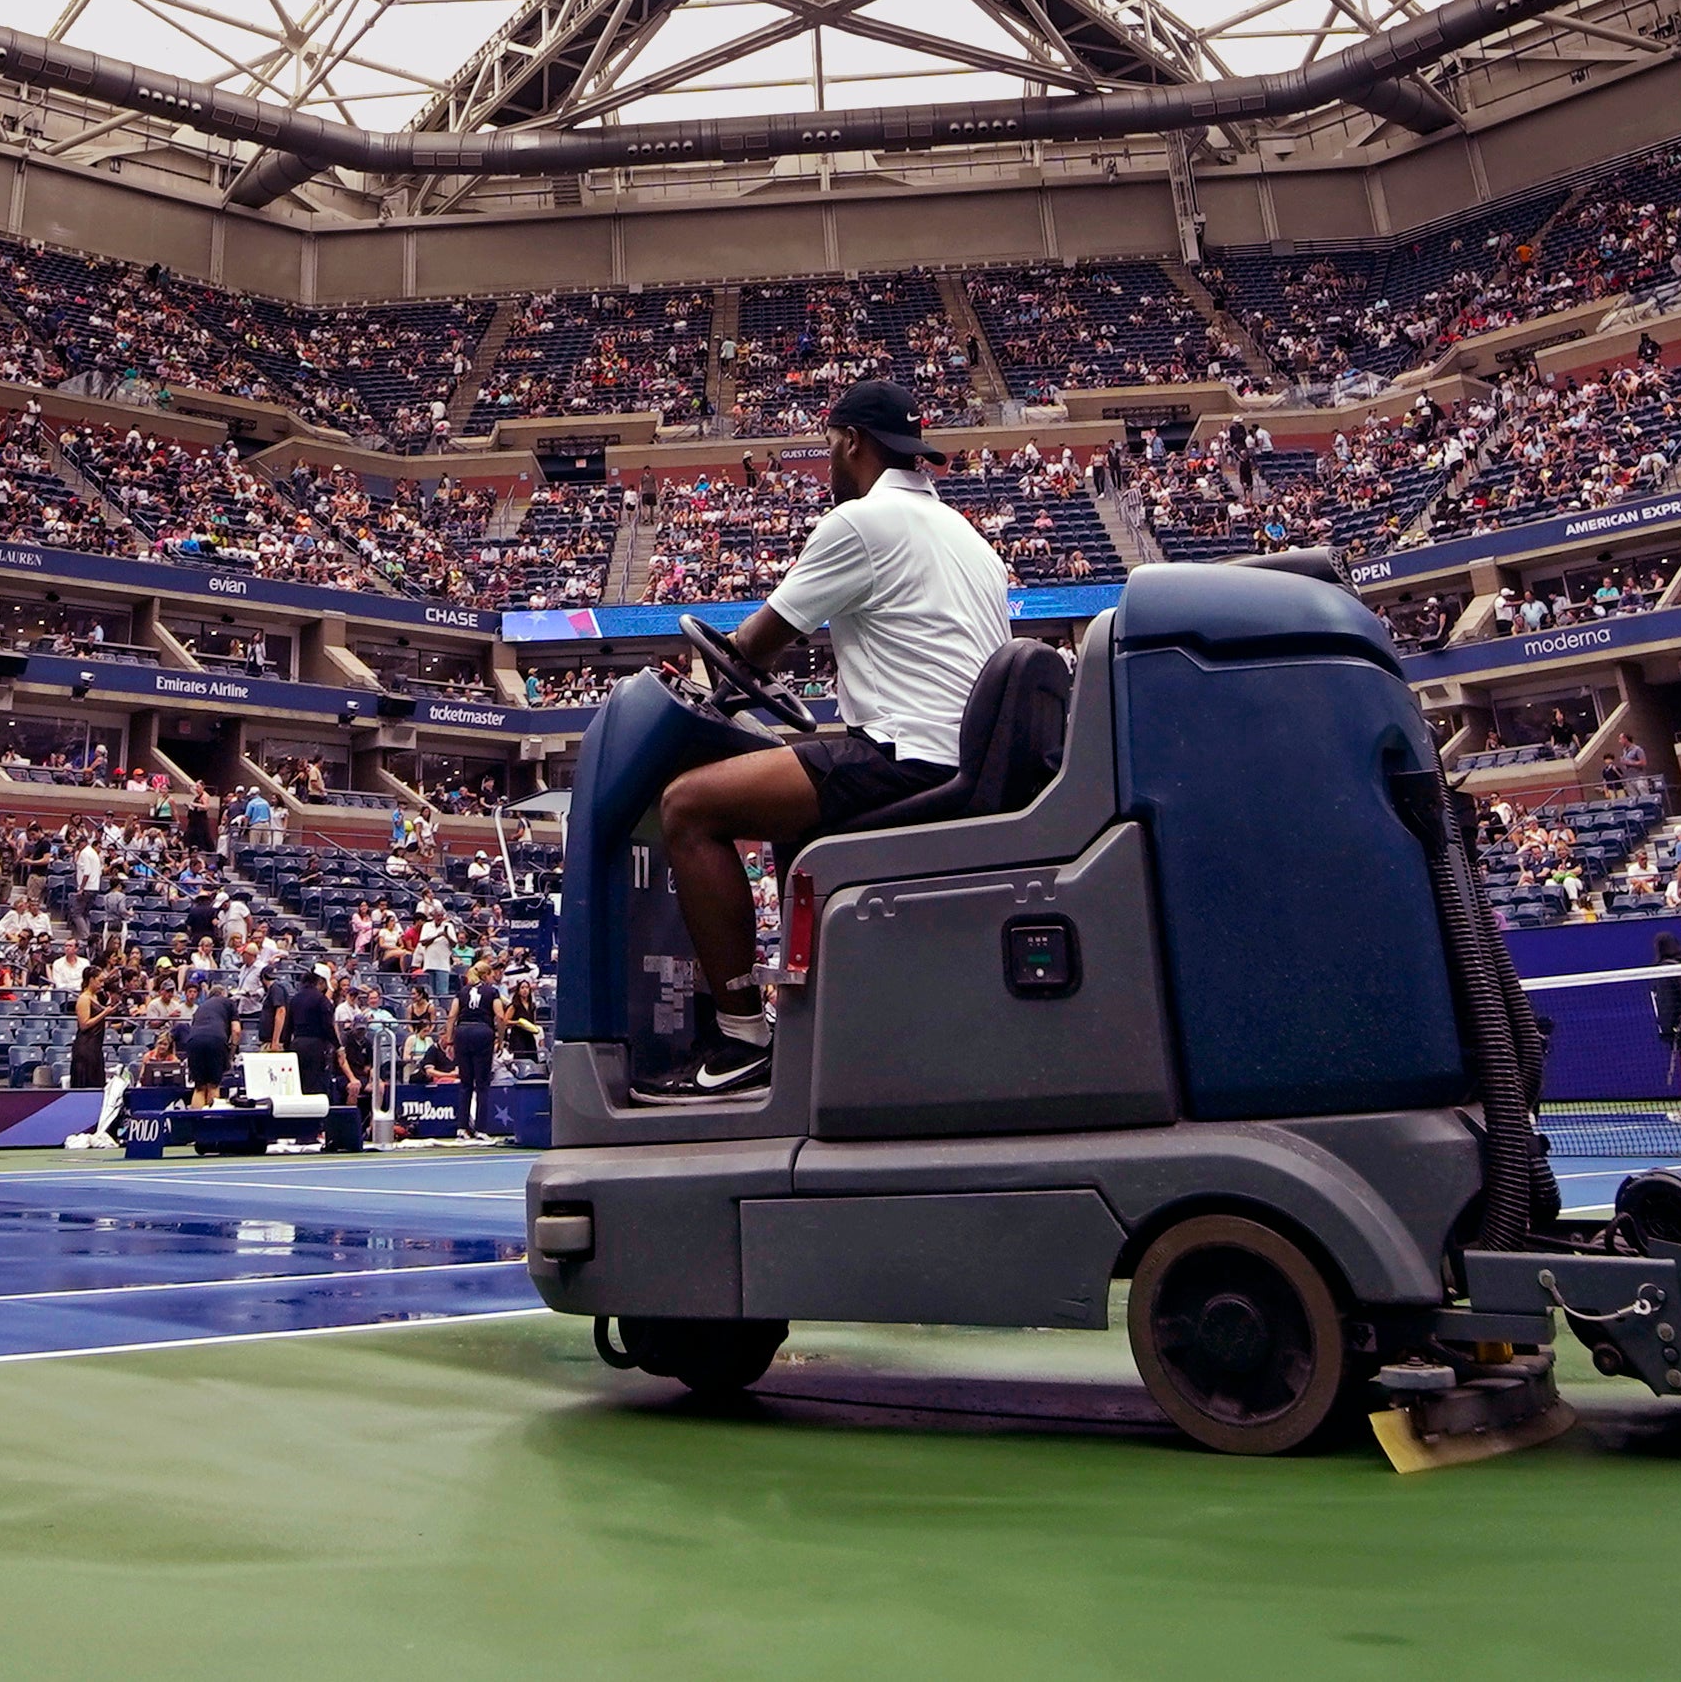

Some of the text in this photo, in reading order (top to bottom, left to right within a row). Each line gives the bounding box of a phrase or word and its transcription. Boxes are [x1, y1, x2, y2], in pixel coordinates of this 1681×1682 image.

[781, 449, 806, 459] GUEST
[1564, 506, 1639, 536] AMERICAN
[1350, 561, 1392, 584] OPEN
[208, 577, 247, 595] evian
[424, 606, 479, 629] CHASE
[1523, 627, 1612, 657] moderna
[155, 674, 250, 700] Emirates Airline
[428, 705, 506, 727] ticketmaster
[401, 1100, 456, 1122] Wilson
[128, 1118, 159, 1142] POLO
